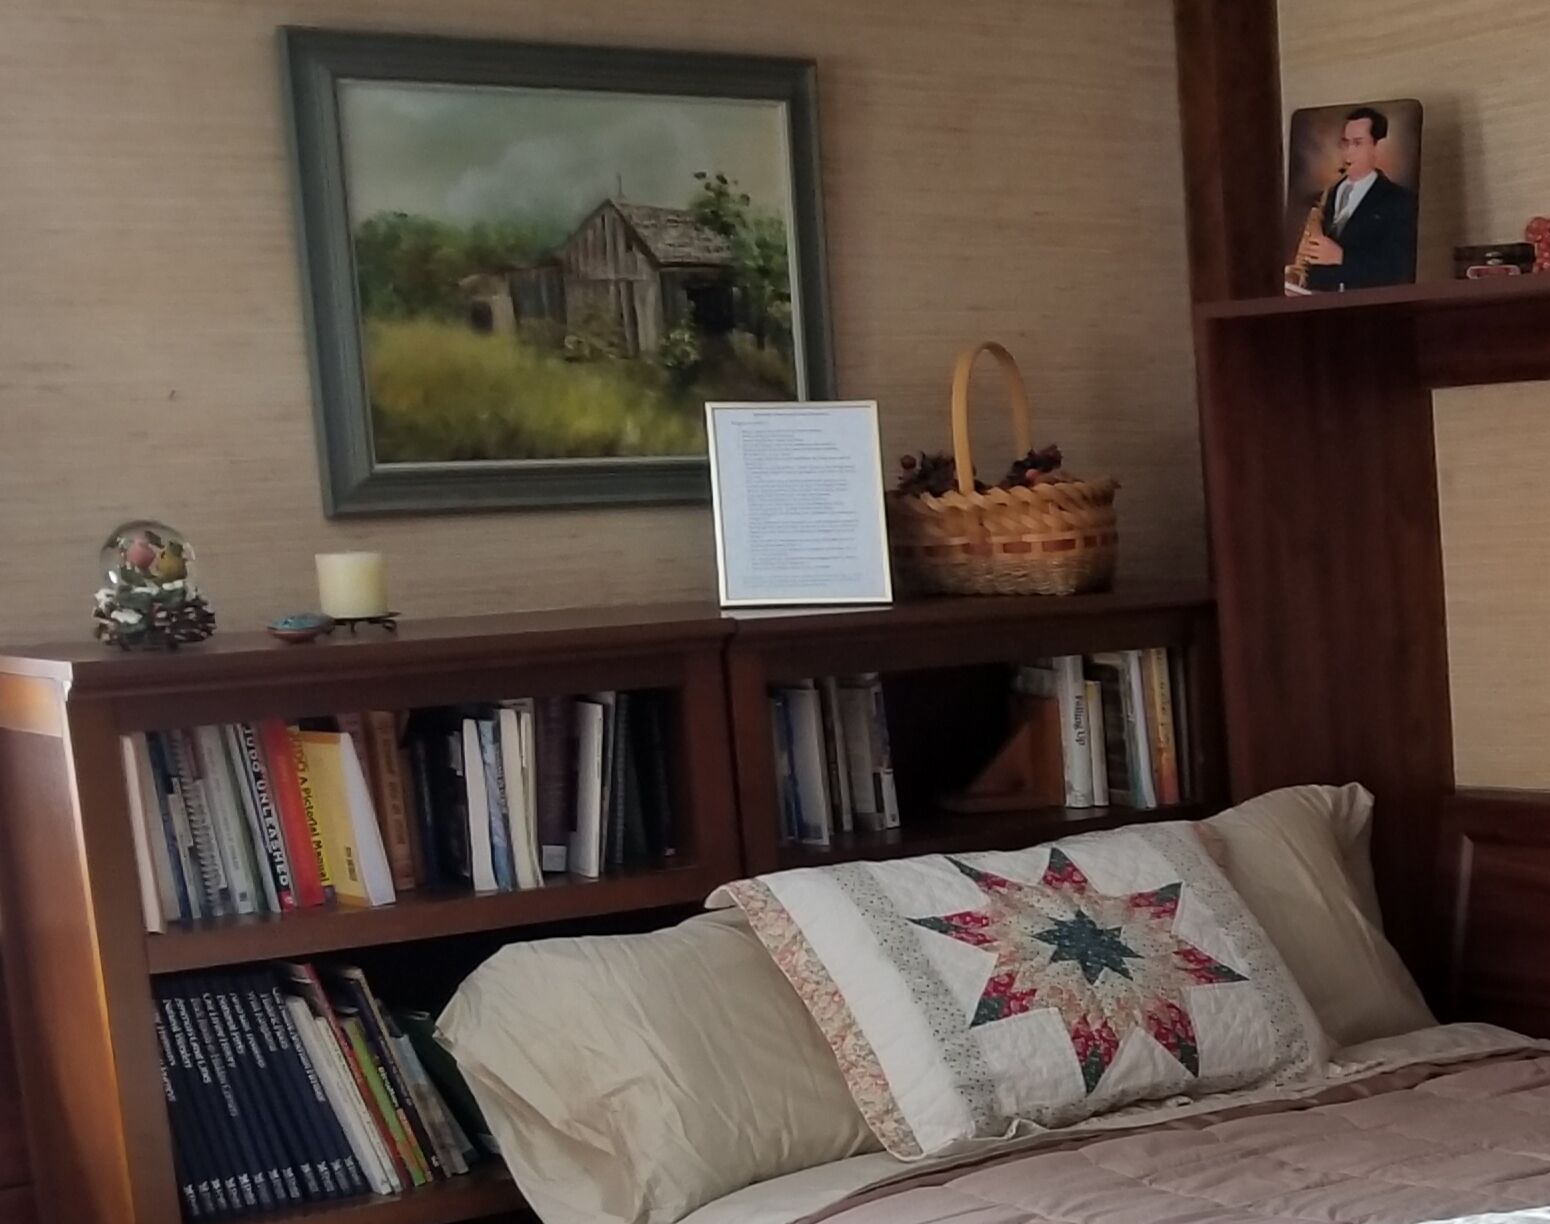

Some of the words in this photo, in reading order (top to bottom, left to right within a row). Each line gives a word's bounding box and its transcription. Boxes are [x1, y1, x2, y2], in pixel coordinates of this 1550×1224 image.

[1073, 695, 1084, 730] Falling
[1075, 731, 1086, 746] Up
[300, 776, 308, 786] A
[243, 728, 263, 773] JUDO
[256, 780, 290, 886] UNLEASHED
[302, 789, 319, 838] Pictorial
[313, 840, 330, 883] Manual
